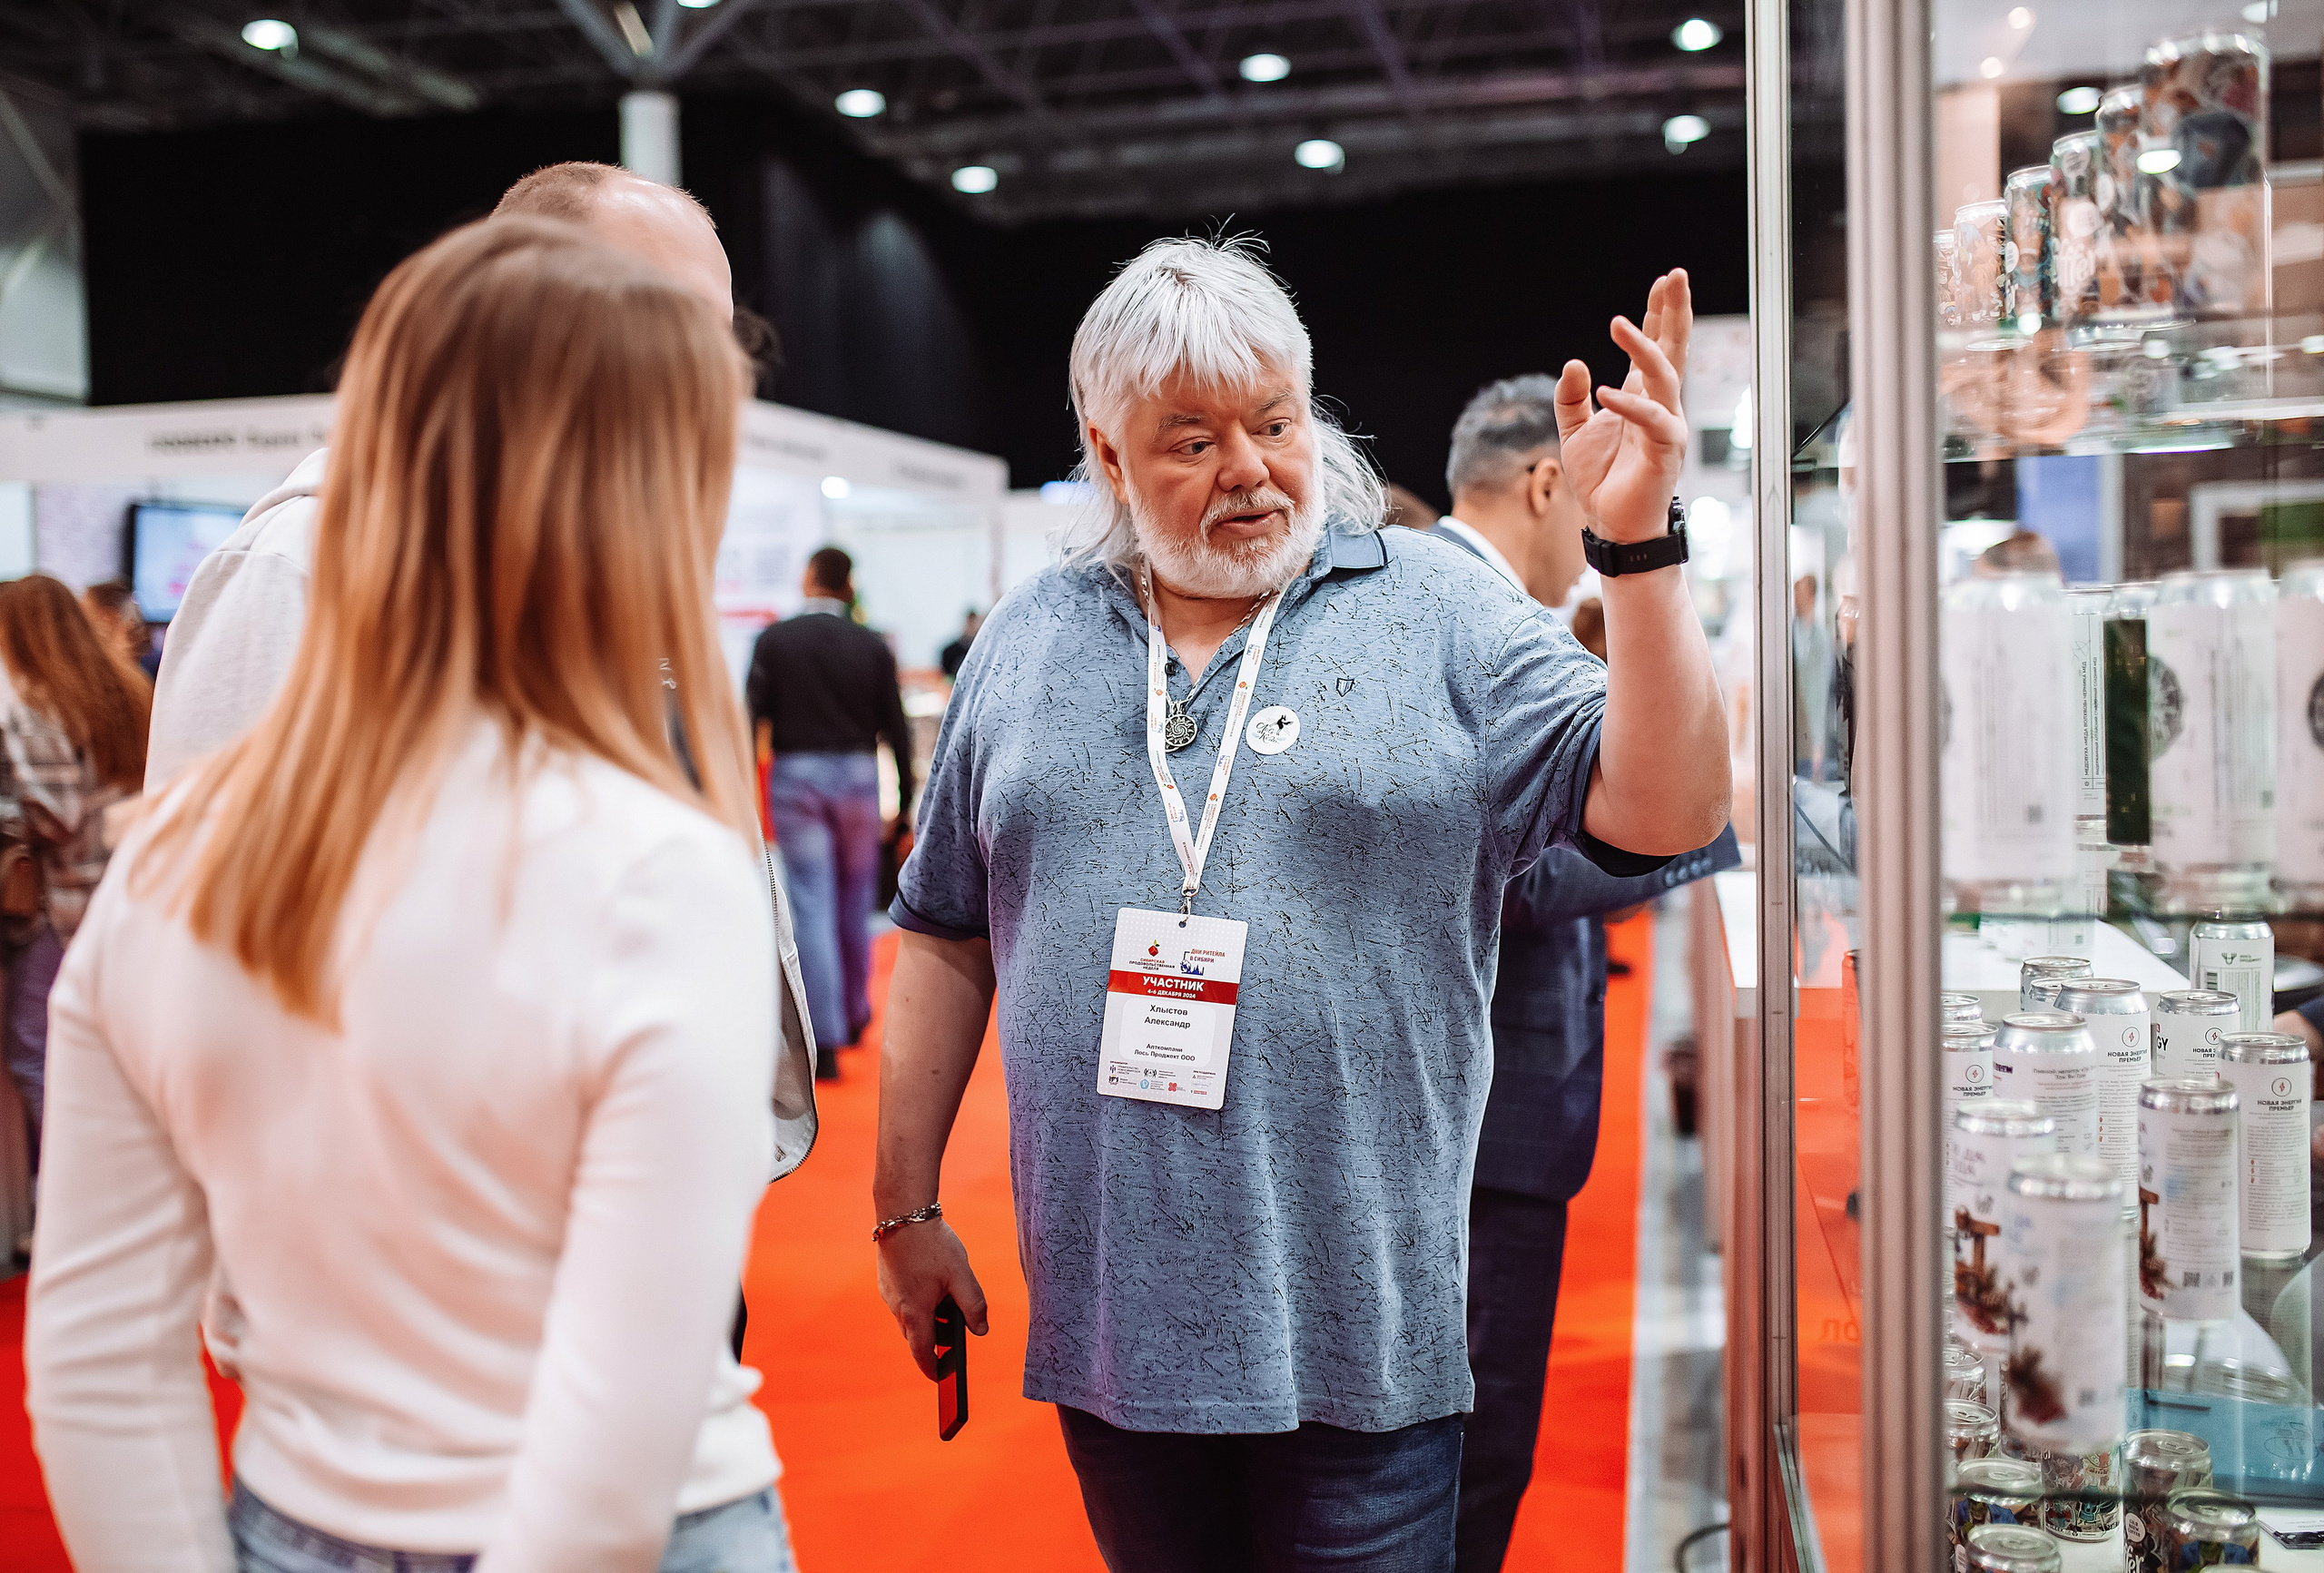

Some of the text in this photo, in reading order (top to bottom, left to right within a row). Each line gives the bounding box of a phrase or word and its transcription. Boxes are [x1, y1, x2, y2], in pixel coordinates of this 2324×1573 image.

[1202, 949, 1226, 958] РИТЕЙЛА
[1128, 960, 1175, 968] ПРОДОВОЛЬСТВЕННАЯ
[1143, 976, 1205, 991] УЧАСТНИК
[1157, 989, 1182, 998] ДЕКАБРЯ
[1149, 1004, 1188, 1016] Хлыстов
[1144, 1017, 1191, 1029] Александр
[1146, 1044, 1183, 1053] Алткомпани
[2130, 1048, 2148, 1057] ЭНЕРГИЯ
[1134, 1048, 1149, 1057] Лось
[1150, 1051, 1179, 1060] Проджект
